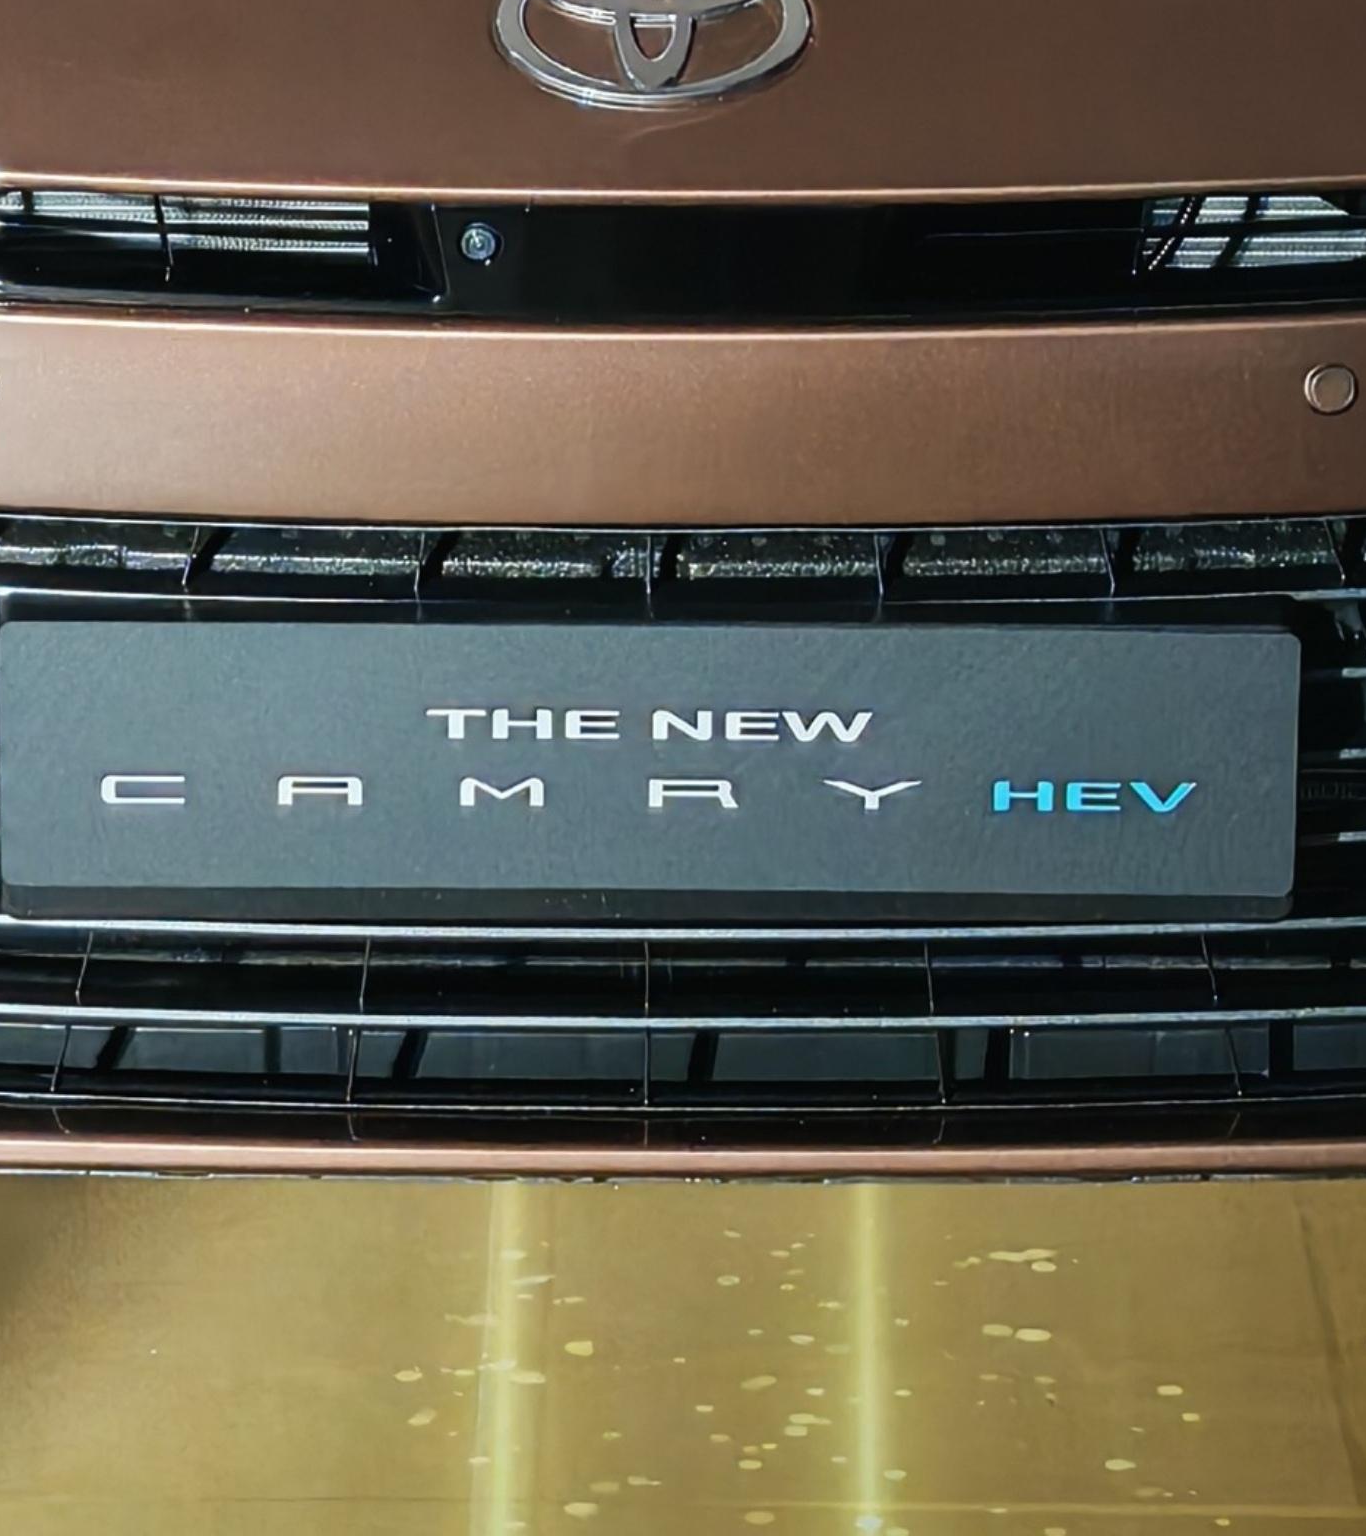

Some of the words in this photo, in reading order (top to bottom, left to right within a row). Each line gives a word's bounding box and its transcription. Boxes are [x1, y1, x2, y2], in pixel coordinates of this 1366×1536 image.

[426, 708, 621, 741] THE
[651, 709, 874, 743] NEW
[100, 775, 922, 811] CAMRY
[990, 780, 1197, 814] HEV
